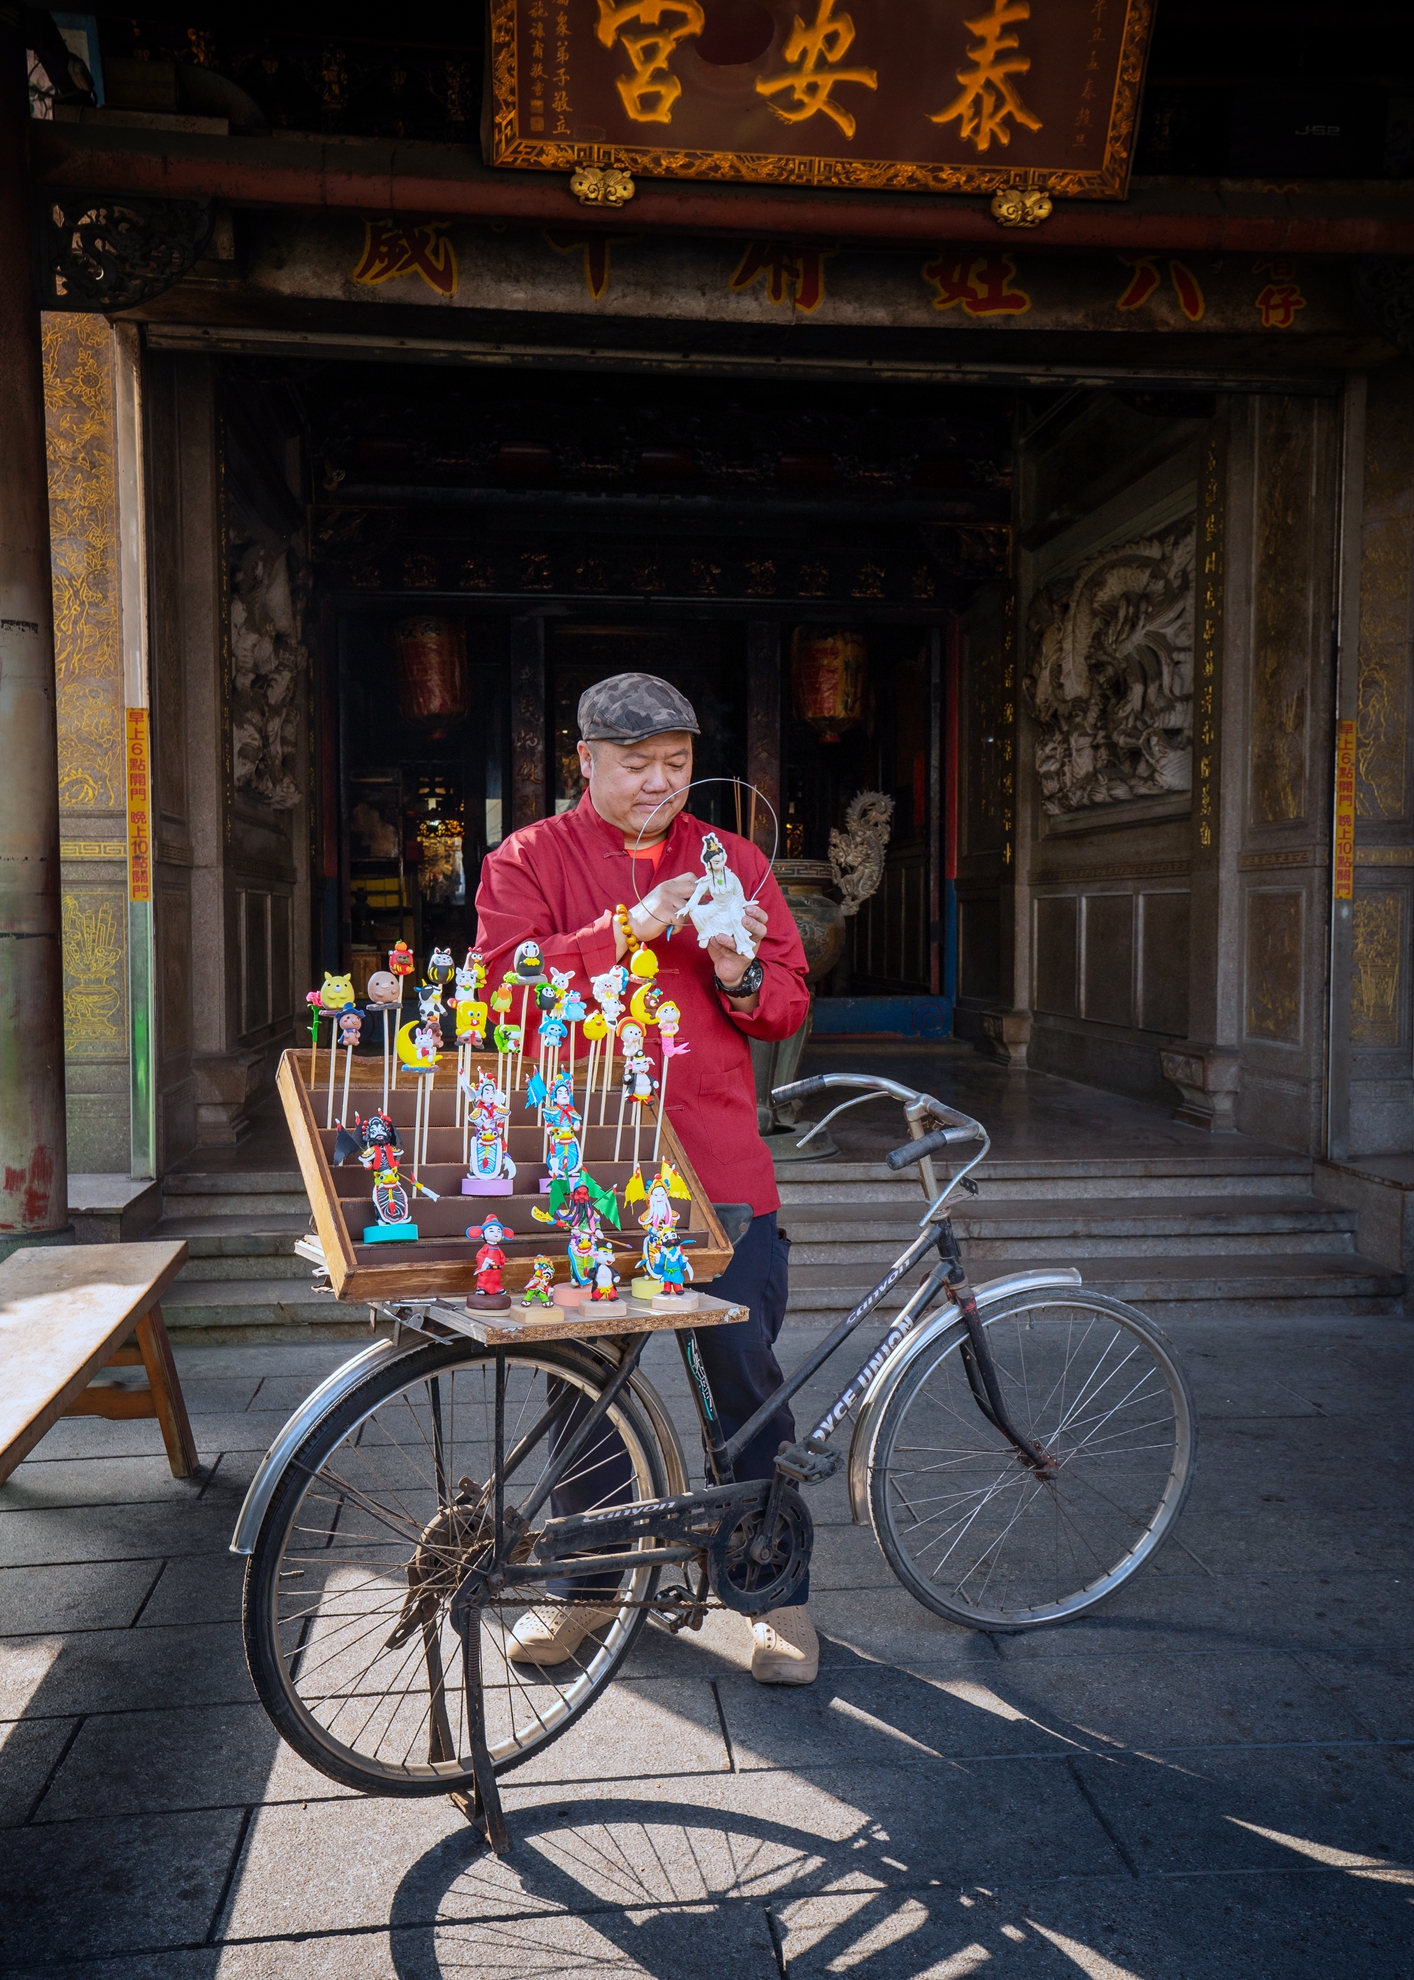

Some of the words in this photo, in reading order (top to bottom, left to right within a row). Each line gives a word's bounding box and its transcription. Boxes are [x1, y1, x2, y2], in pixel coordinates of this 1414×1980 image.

[128, 711, 147, 801] 早上6點開門
[1338, 723, 1354, 807] 早上6點開門
[857, 1315, 913, 1388] UNION
